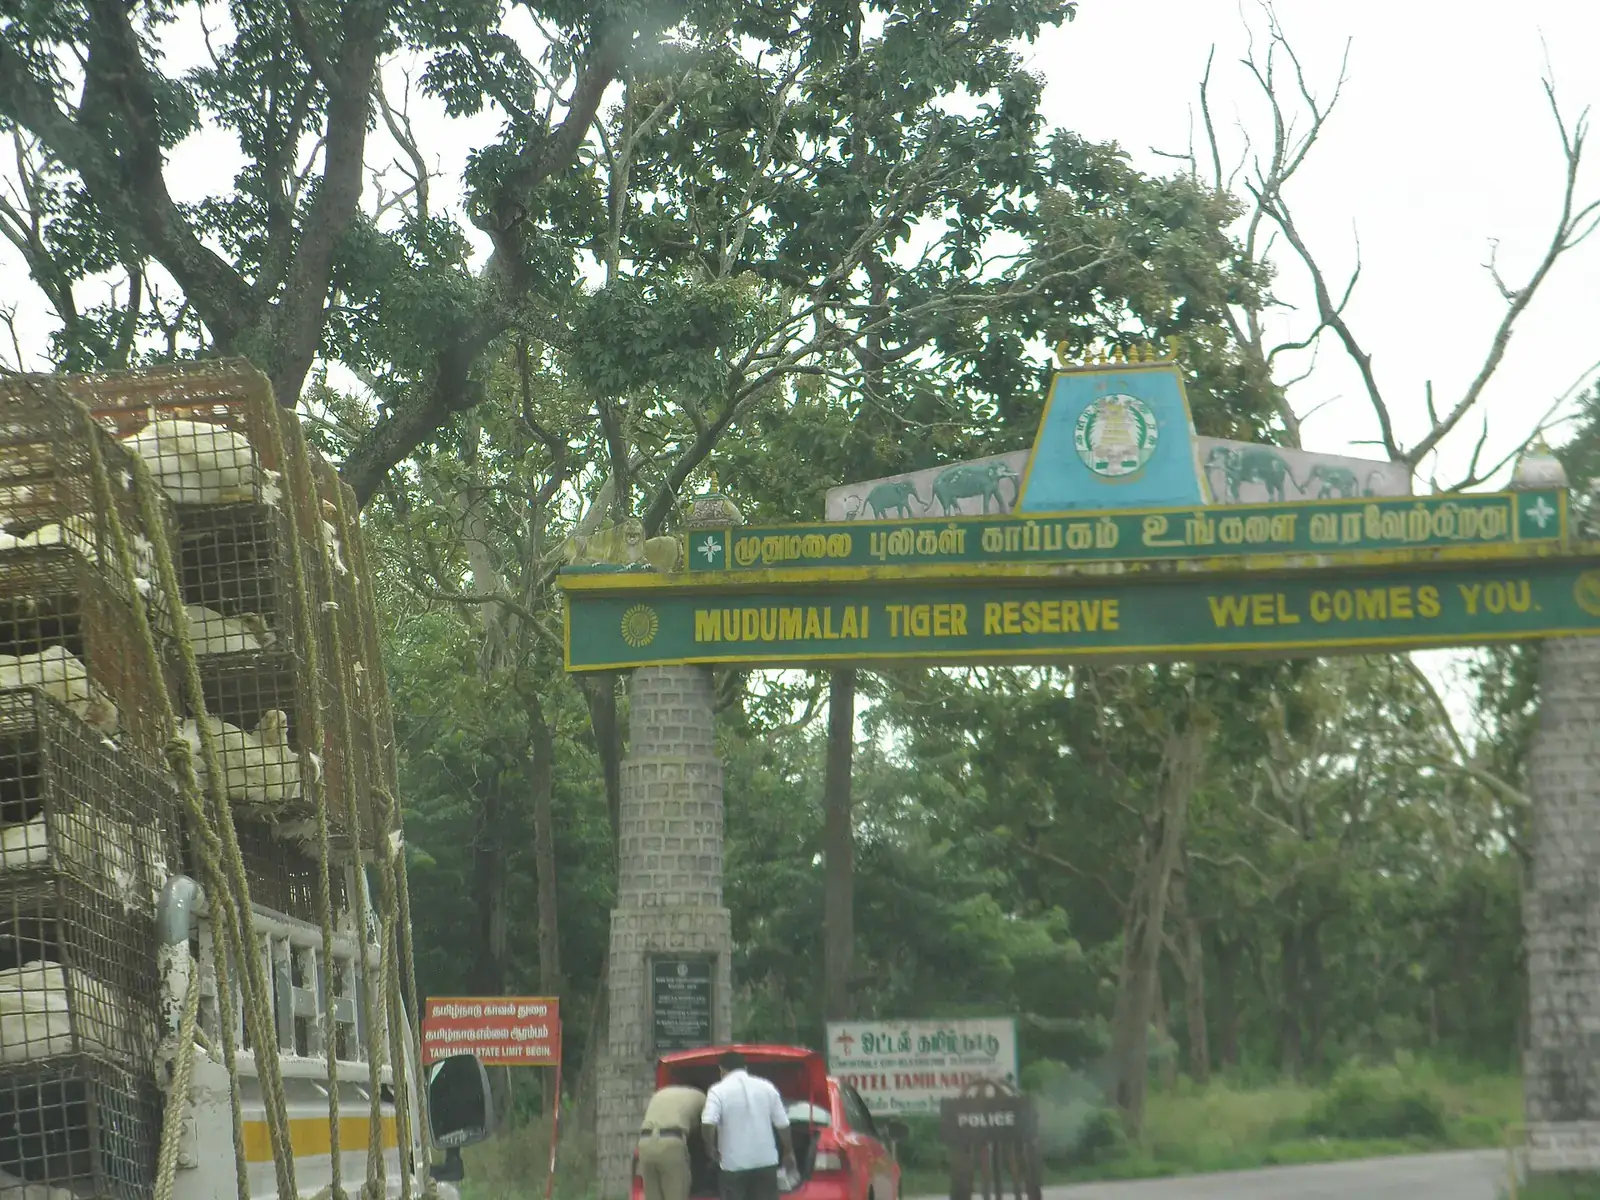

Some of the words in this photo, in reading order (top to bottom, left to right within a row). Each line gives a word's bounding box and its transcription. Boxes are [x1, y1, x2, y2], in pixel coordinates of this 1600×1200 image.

[869, 523, 967, 561] புலிகள்
[981, 516, 1120, 552] காப்பகம்
[1142, 511, 1298, 547] உங்களை
[1309, 502, 1507, 544] வரவேற்கிறது
[694, 606, 869, 642] MUDUMALAI
[886, 603, 968, 638] TIGER
[984, 600, 1120, 636] RESERVE
[432, 1004, 482, 1019] தமிழ்நாடு
[484, 1003, 516, 1016] காவல்
[517, 1005, 547, 1019] துறை
[476, 1047, 500, 1057] STATE
[501, 1045, 523, 1057] LIMIT
[525, 1045, 550, 1057] BEGIN
[957, 1111, 1017, 1128] POLICE
